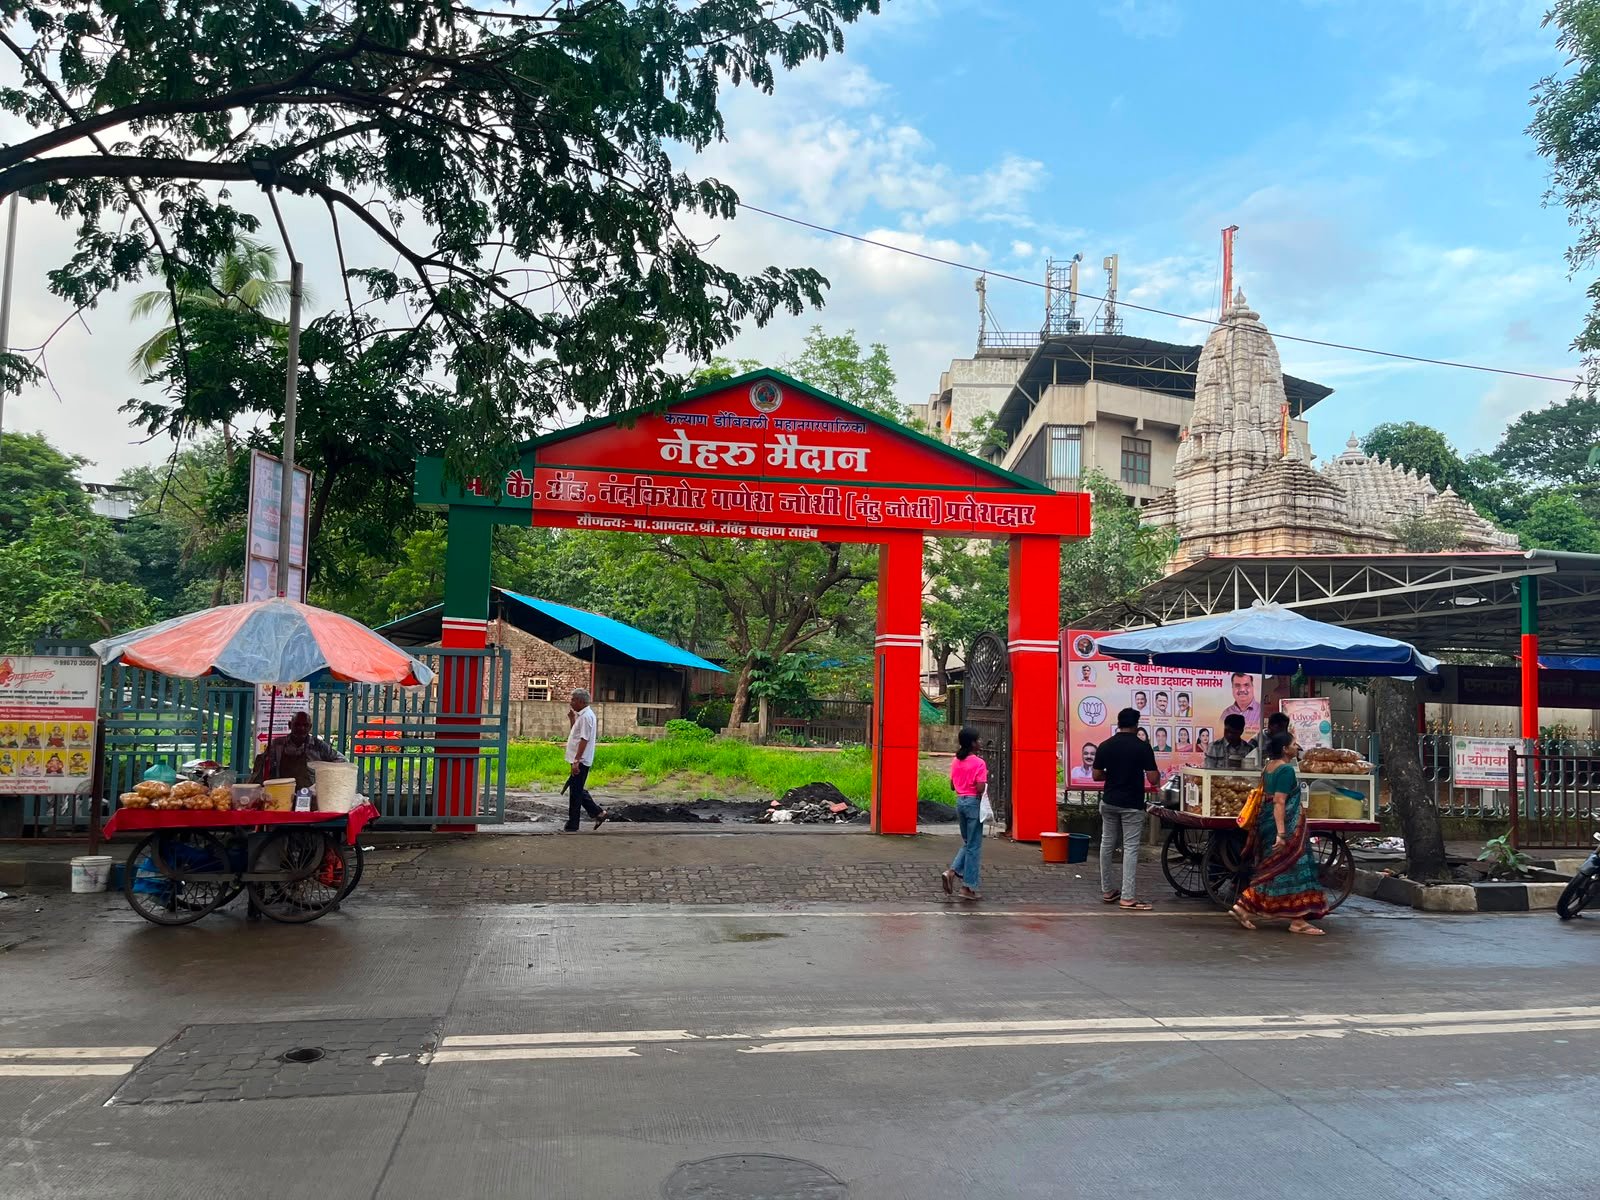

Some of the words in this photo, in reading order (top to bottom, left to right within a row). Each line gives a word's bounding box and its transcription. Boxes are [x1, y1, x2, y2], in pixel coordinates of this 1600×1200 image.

[664, 412, 709, 426] कल्याण
[713, 411, 769, 430] डोंबिवली
[773, 417, 868, 434] महानगरपालिका
[764, 434, 872, 473] मैदान
[598, 475, 707, 508] नंदकिशोर
[711, 482, 774, 512] गणेश
[779, 486, 842, 516] जोशी
[944, 495, 1036, 528] प्रवेशद्वार
[749, 524, 785, 538] चव्हाण
[788, 524, 819, 540] साहेब
[1117, 672, 1134, 685] वेदर
[1136, 673, 1159, 685] शेडचा
[1196, 675, 1223, 688] समारंभ
